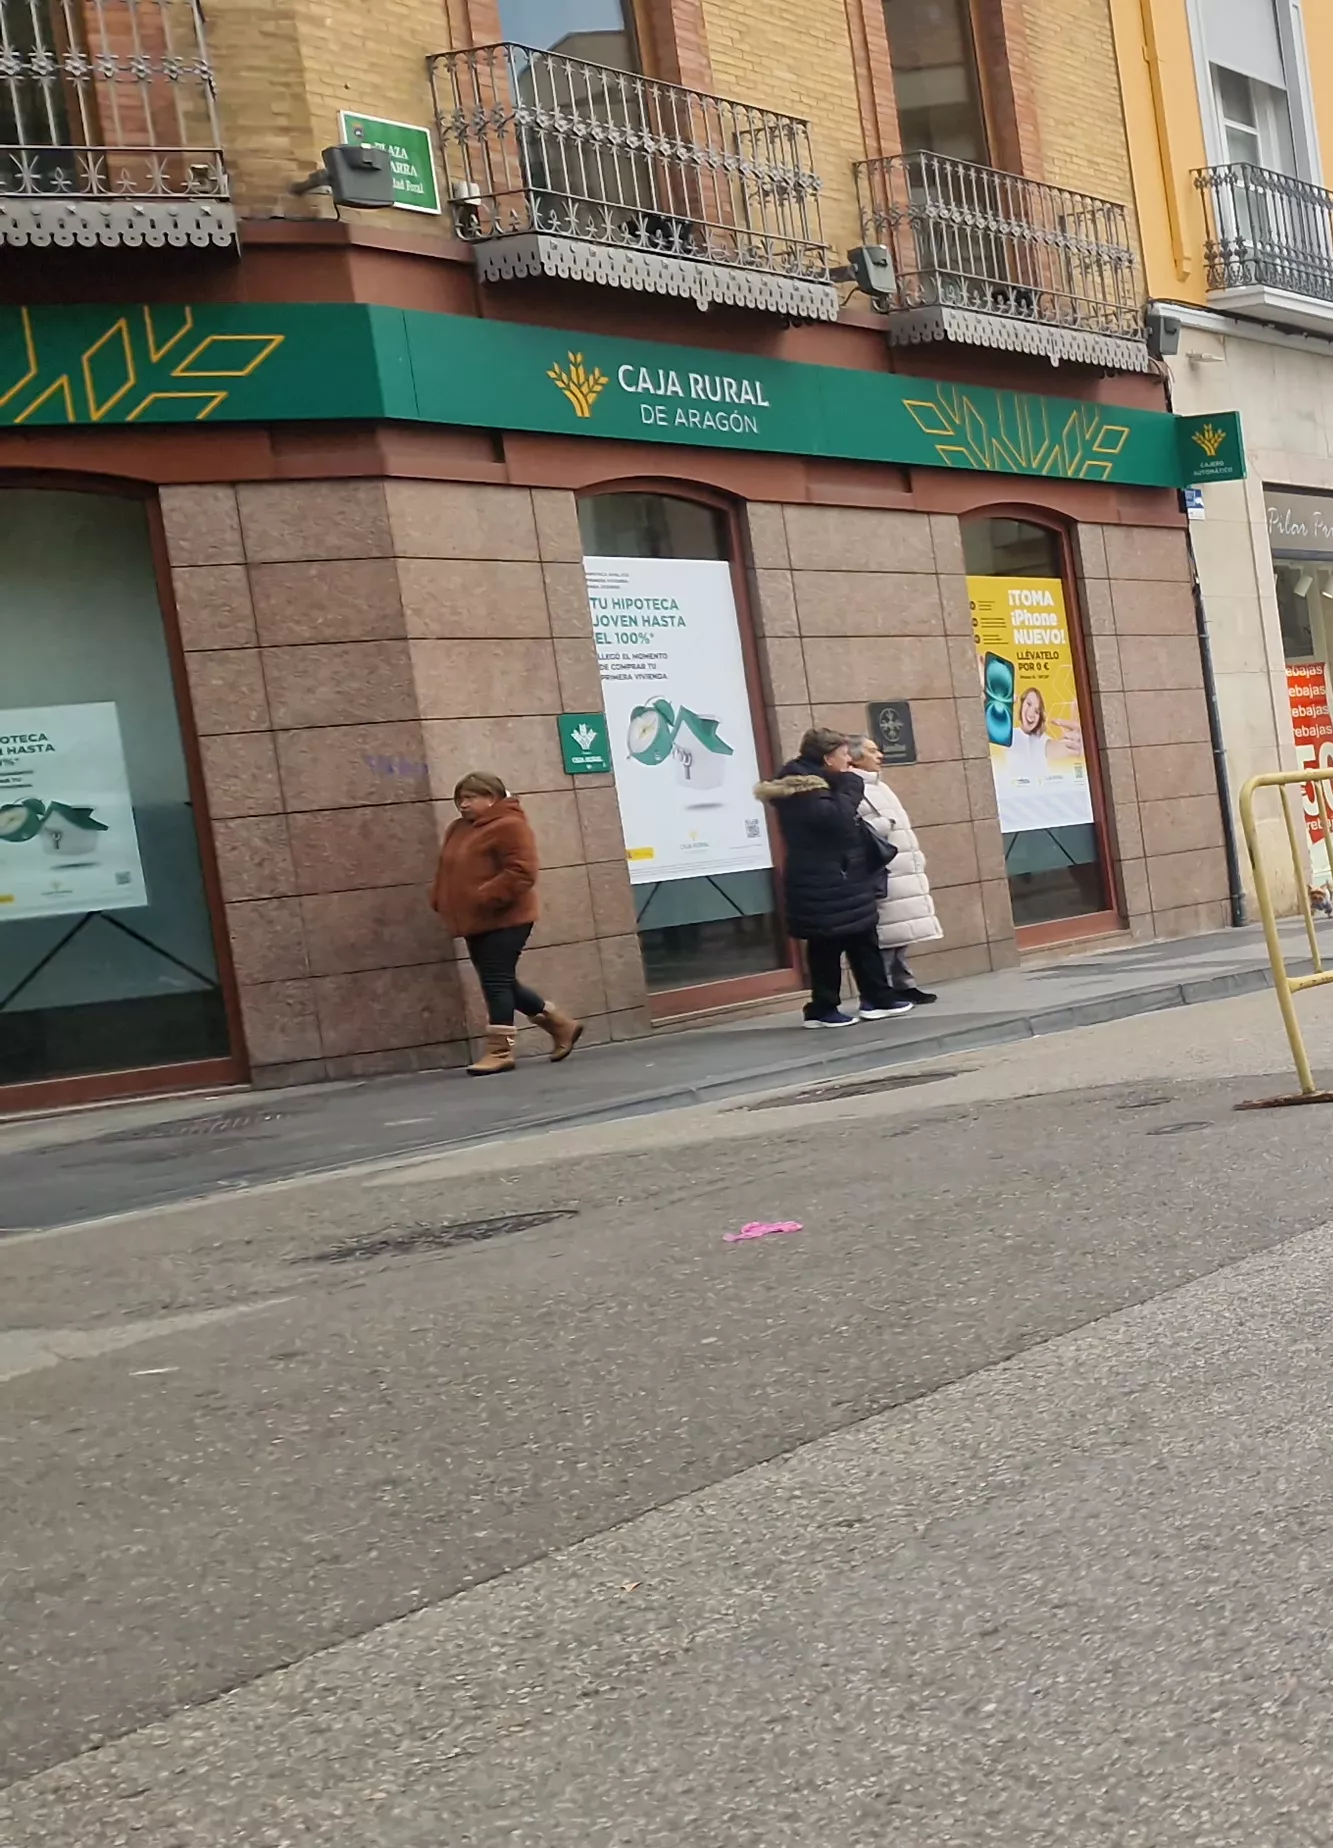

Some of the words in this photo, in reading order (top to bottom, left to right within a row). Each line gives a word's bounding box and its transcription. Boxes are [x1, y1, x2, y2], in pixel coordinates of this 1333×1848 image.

[618, 364, 685, 397] CAJA
[688, 372, 770, 407] RURAL
[640, 403, 669, 426] DE
[674, 408, 759, 434] ARAGÓN
[1267, 507, 1309, 537] Pilar
[589, 597, 608, 610] TU
[611, 598, 680, 610] HIPOTECA
[593, 615, 638, 627] JOVEN
[641, 615, 686, 627] HASTA
[595, 632, 612, 645] EL
[1013, 629, 1066, 645] NUEVO!
[1018, 662, 1035, 671] POR
[1290, 704, 1329, 719] ebajas
